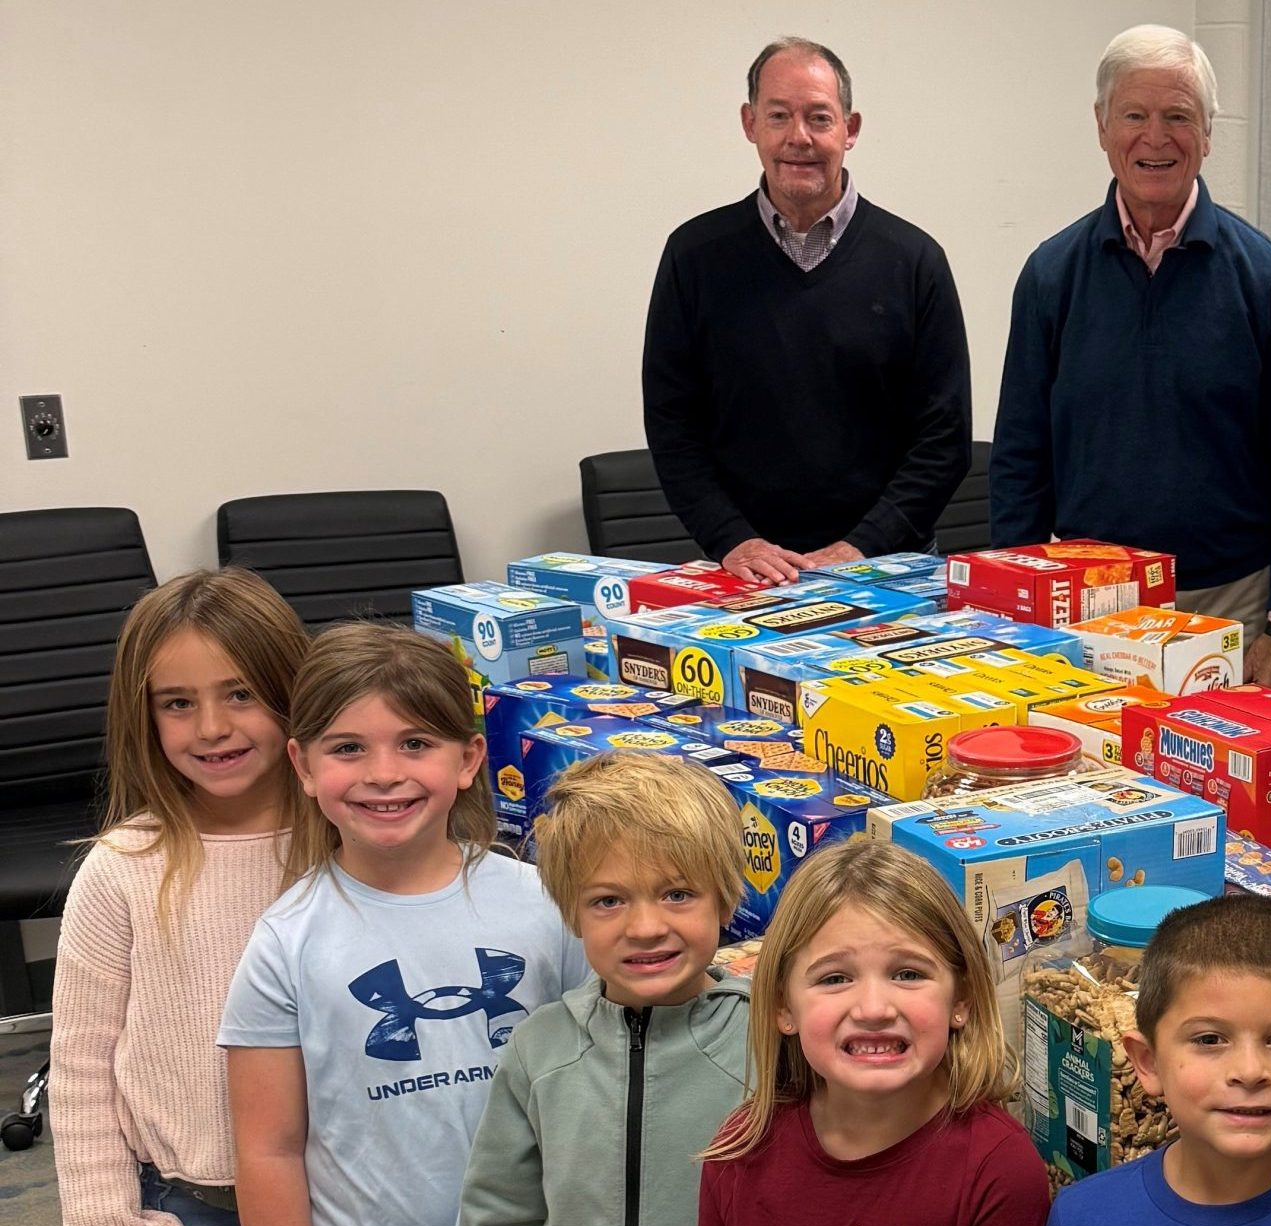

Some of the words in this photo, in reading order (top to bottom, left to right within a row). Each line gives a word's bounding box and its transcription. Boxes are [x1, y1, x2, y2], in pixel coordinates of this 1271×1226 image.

[601, 583, 624, 602] 90
[606, 600, 626, 610] COUNT
[1052, 579, 1071, 628] EEZ-IT
[477, 620, 495, 640] 90
[1223, 635, 1230, 650] 3
[622, 660, 667, 683] SNYDER'S
[680, 652, 714, 688] 60
[676, 682, 721, 703] ON-THE-GO
[751, 694, 791, 717] SNYDER'S
[814, 728, 888, 793] Cheerios
[1105, 742, 1113, 758] 3
[792, 825, 801, 841] 4
[1061, 1057, 1095, 1082] CRACKERS
[1065, 1051, 1090, 1071] ANIMAL
[367, 1071, 451, 1101] UNDER
[454, 1064, 499, 1085] ARM
